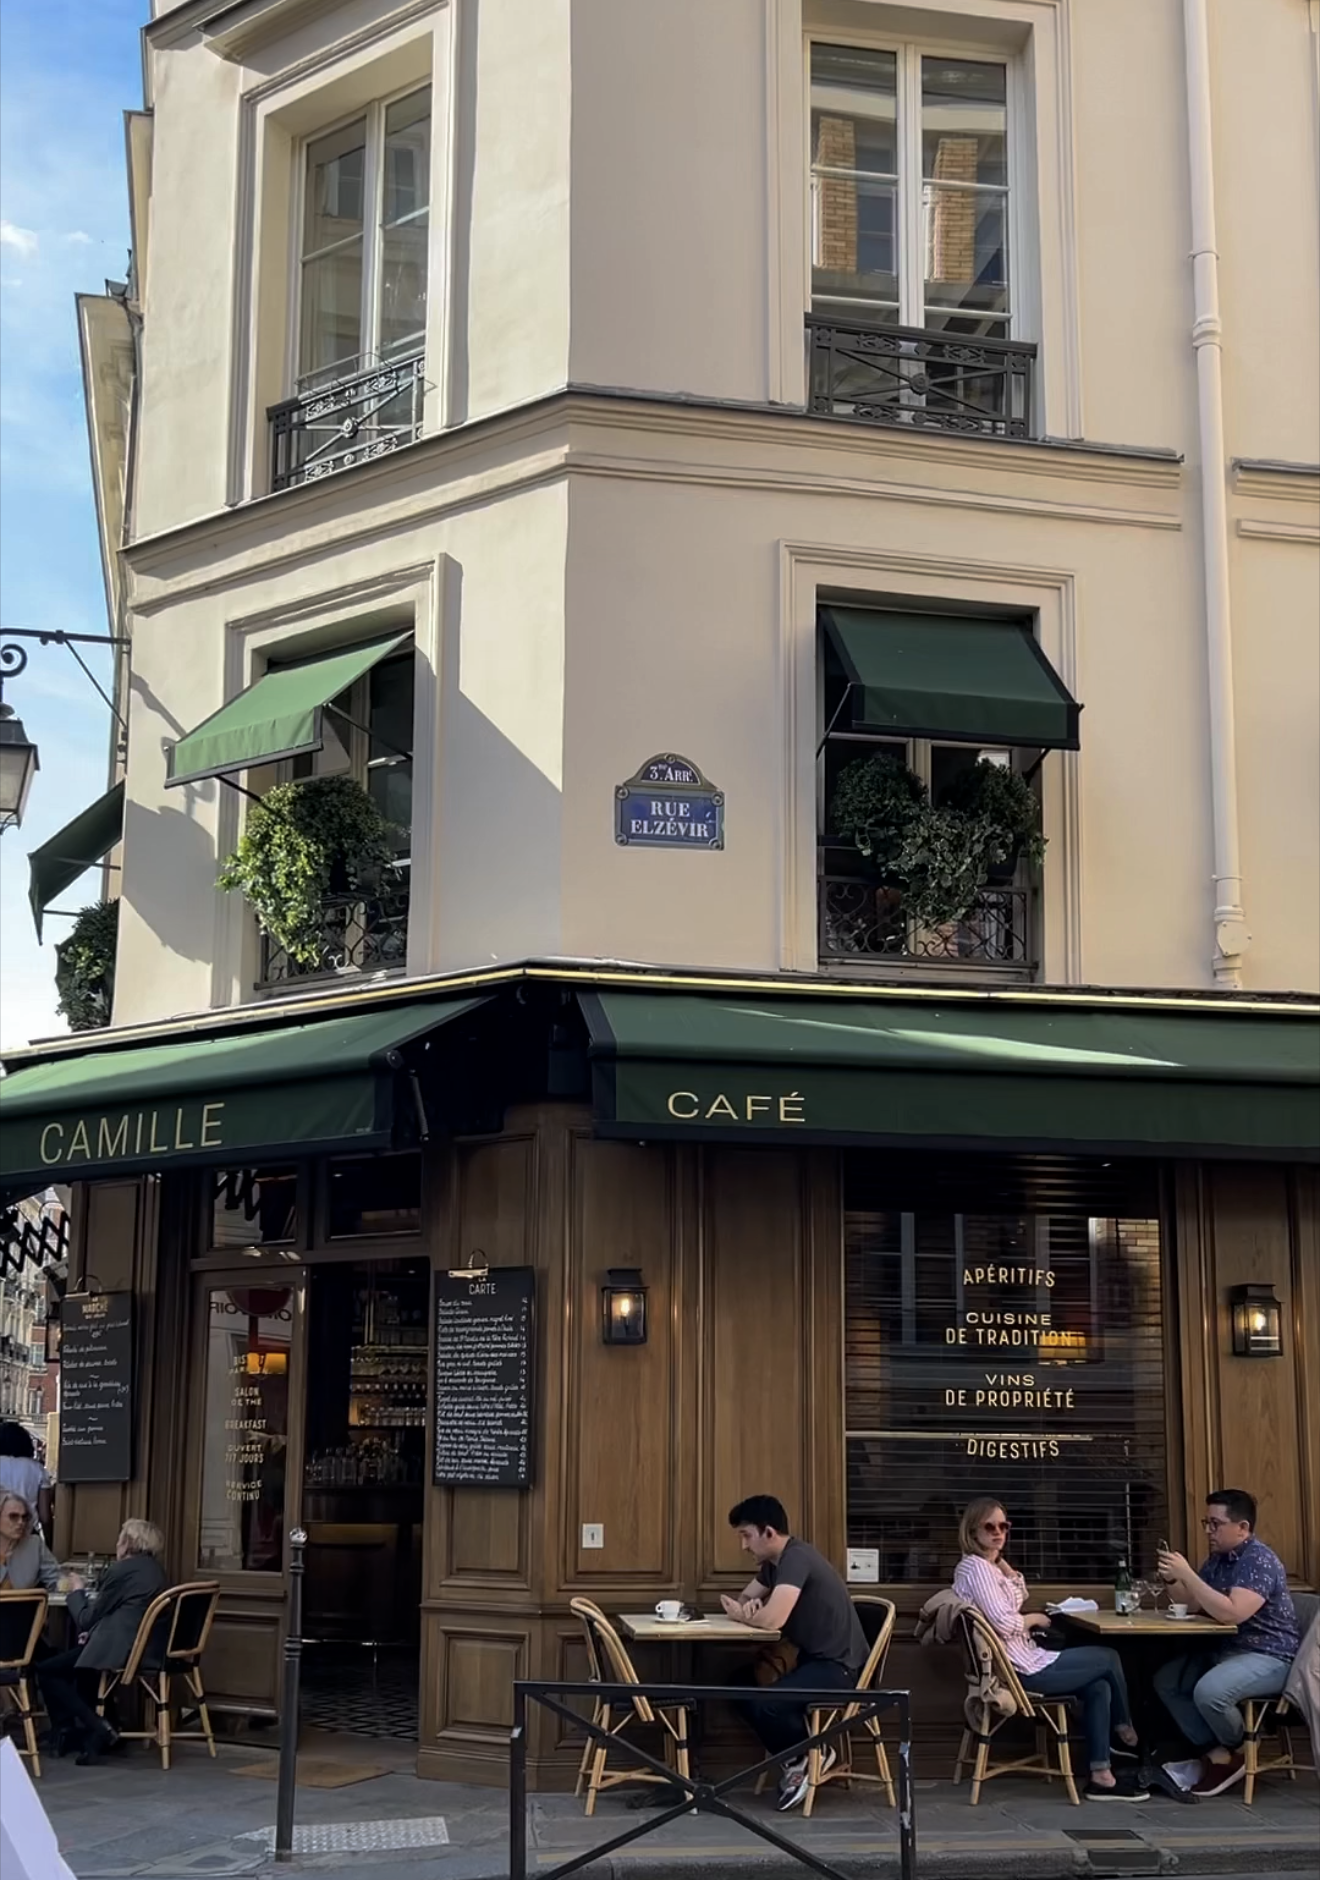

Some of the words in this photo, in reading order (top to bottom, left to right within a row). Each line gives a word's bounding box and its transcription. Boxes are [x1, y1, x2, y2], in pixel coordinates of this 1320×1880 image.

[651, 801, 690, 817] RUE
[631, 818, 709, 837] ELZÉVIR
[668, 1091, 805, 1122] CAFÉ
[40, 1103, 224, 1164] CAMILLE
[963, 1263, 1055, 1287] APÉRITIFS
[469, 1283, 497, 1295] CARTE
[966, 1312, 1051, 1325] CUISINE
[945, 1328, 967, 1344] DE
[976, 1328, 1071, 1345] TRADITION
[985, 1374, 1034, 1386] VINS
[235, 1387, 259, 1397] SALON
[945, 1389, 967, 1406] DE
[976, 1387, 1075, 1408] PROPRIÉTÉ
[225, 1419, 267, 1429] BREAKFAST
[228, 1444, 262, 1452] OUVERT
[967, 1438, 1059, 1459] DIGESTIFS
[239, 1453, 264, 1463] JOURS
